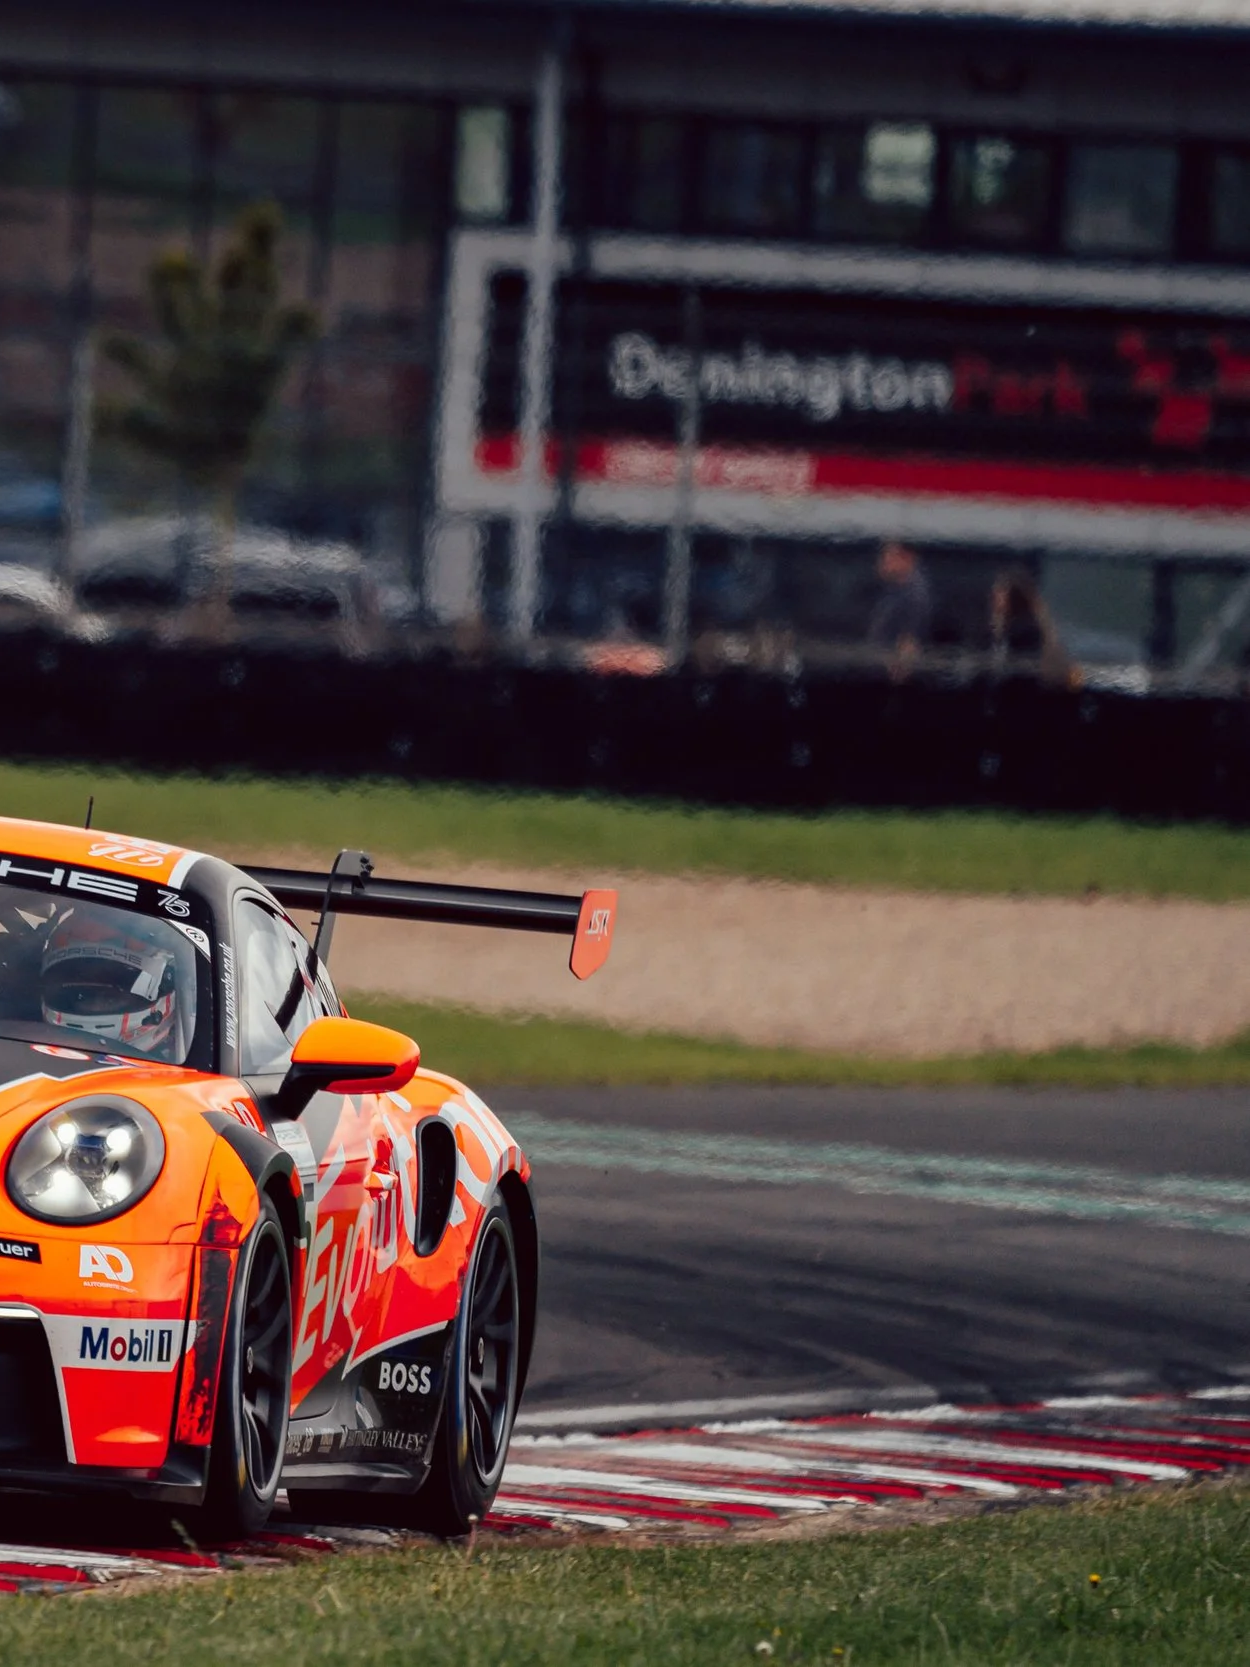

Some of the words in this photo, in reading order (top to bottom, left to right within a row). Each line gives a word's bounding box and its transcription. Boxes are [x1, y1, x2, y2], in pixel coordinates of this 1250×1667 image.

[157, 889, 190, 917] 75
[219, 942, 238, 1049] www.porsche.co.uk
[79, 1245, 134, 1283] AD
[79, 1325, 153, 1362] Mobil
[379, 1361, 432, 1394] BOSS
